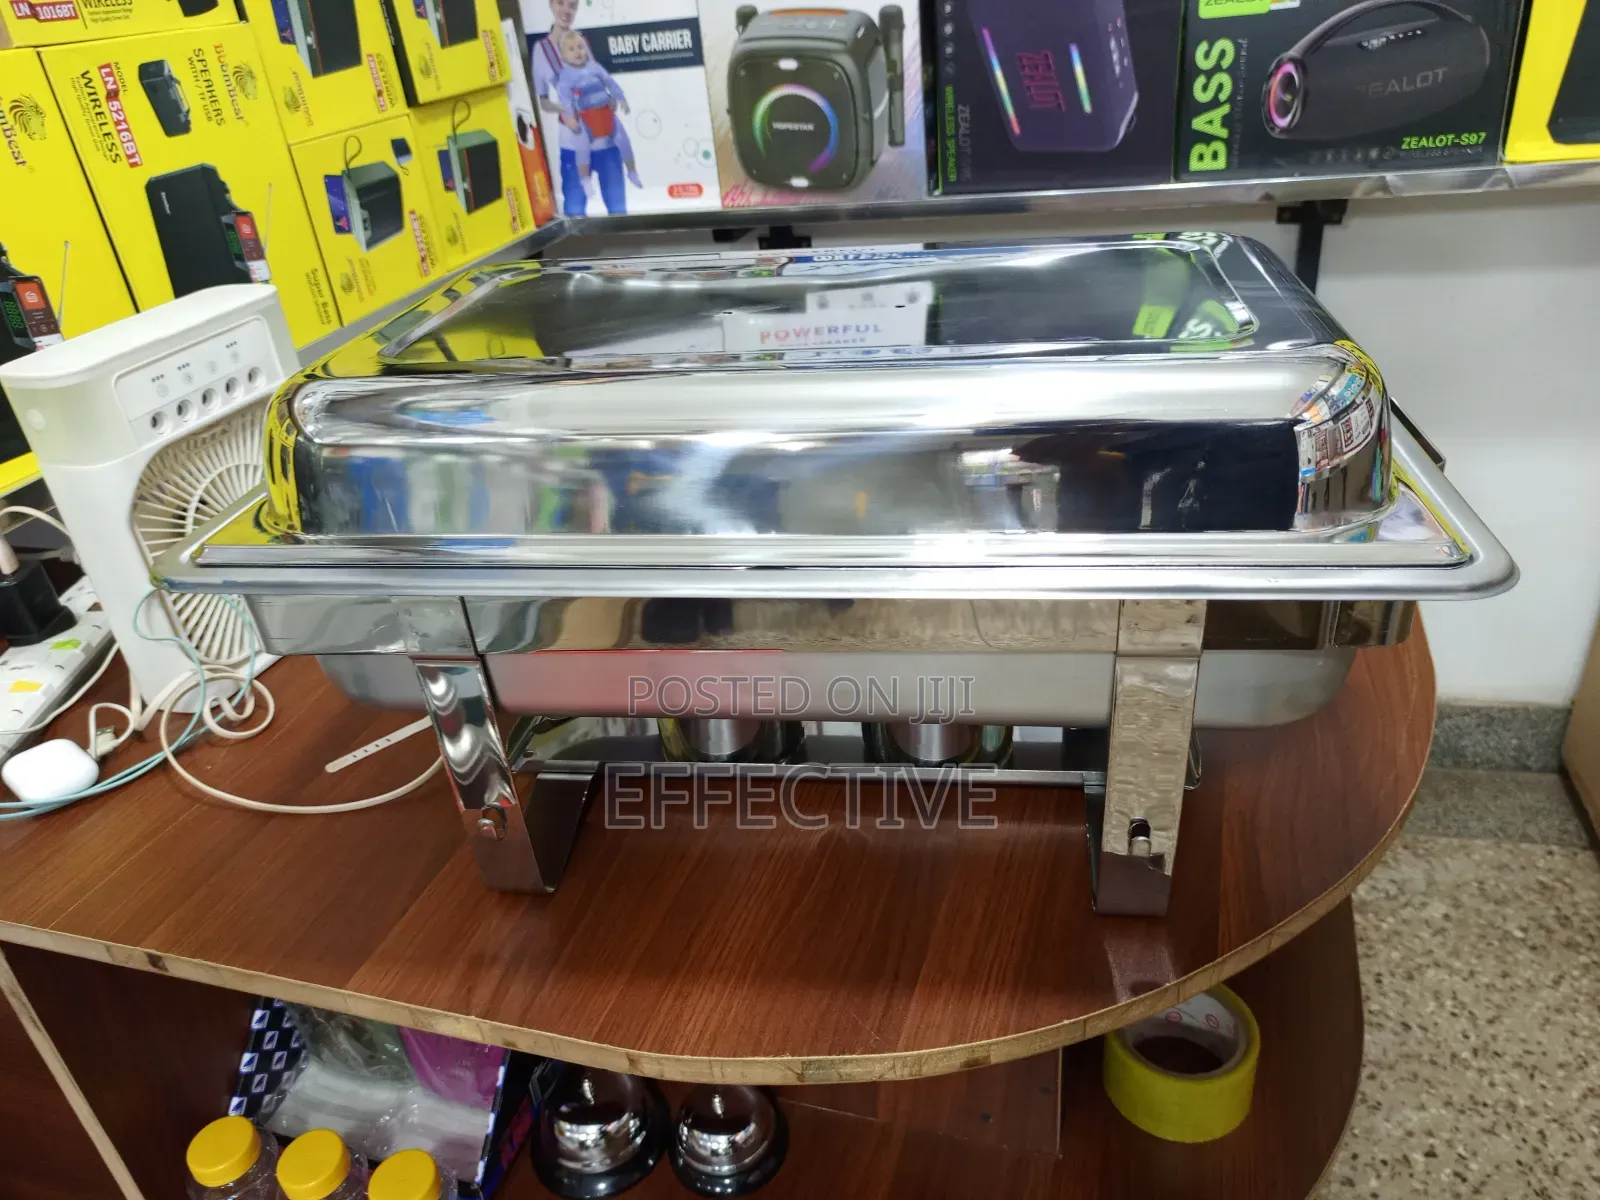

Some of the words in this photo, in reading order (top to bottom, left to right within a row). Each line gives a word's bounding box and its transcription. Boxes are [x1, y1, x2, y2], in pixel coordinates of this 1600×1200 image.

[607, 34, 640, 56] BABY
[641, 28, 693, 52] CARRIER
[113, 62, 128, 92] MODEL
[80, 70, 122, 163] WIRELESS
[1189, 37, 1234, 171] BASS
[1401, 131, 1487, 150] ZEALOT-S97
[759, 323, 883, 344] POWERFUL
